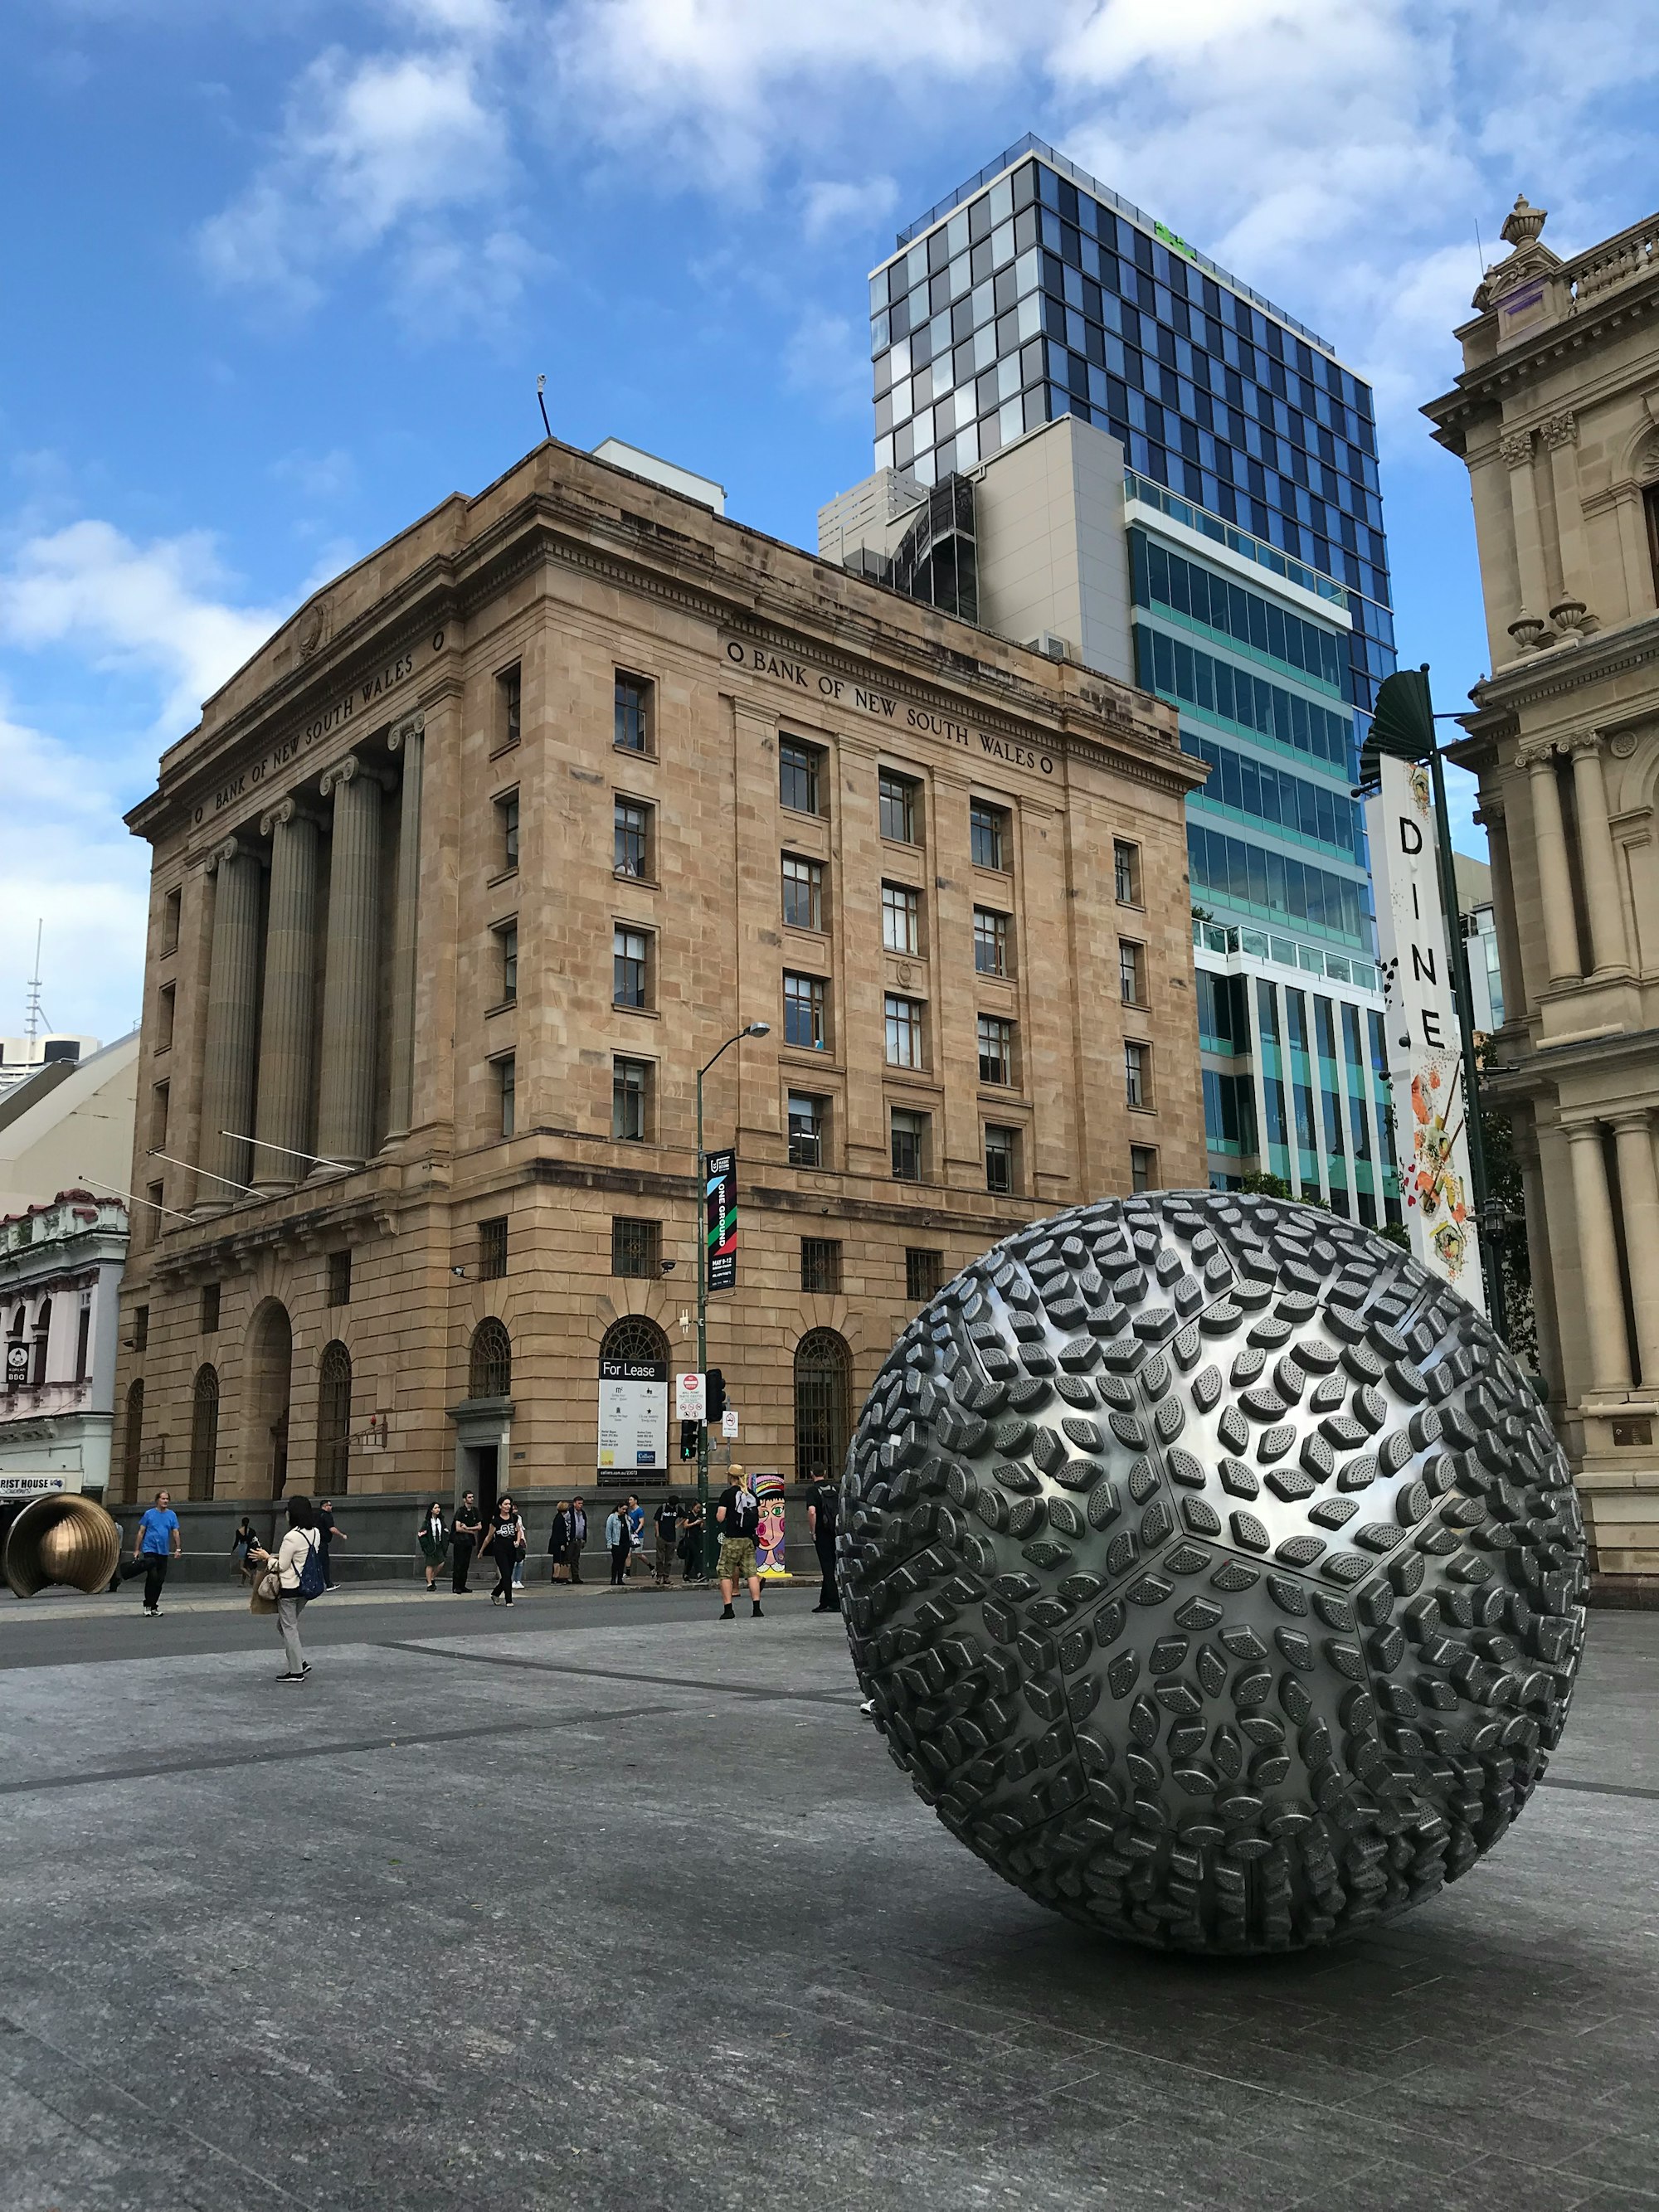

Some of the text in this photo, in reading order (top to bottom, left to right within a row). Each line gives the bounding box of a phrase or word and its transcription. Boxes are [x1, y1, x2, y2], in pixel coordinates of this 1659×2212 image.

[216, 775, 246, 810] BANK
[252, 759, 268, 782] OF
[273, 735, 299, 769] NEW
[305, 695, 353, 746] SOUTH
[362, 654, 412, 703] WALES
[753, 649, 809, 688] BANK
[818, 676, 844, 699] OF
[854, 688, 897, 718] NEW
[907, 708, 969, 746] SOUTH
[979, 733, 1034, 769] WALES
[1399, 816, 1445, 1049] DINE
[603, 1361, 655, 1377] For Lease
[21, 1480, 48, 1488] HOUSE
